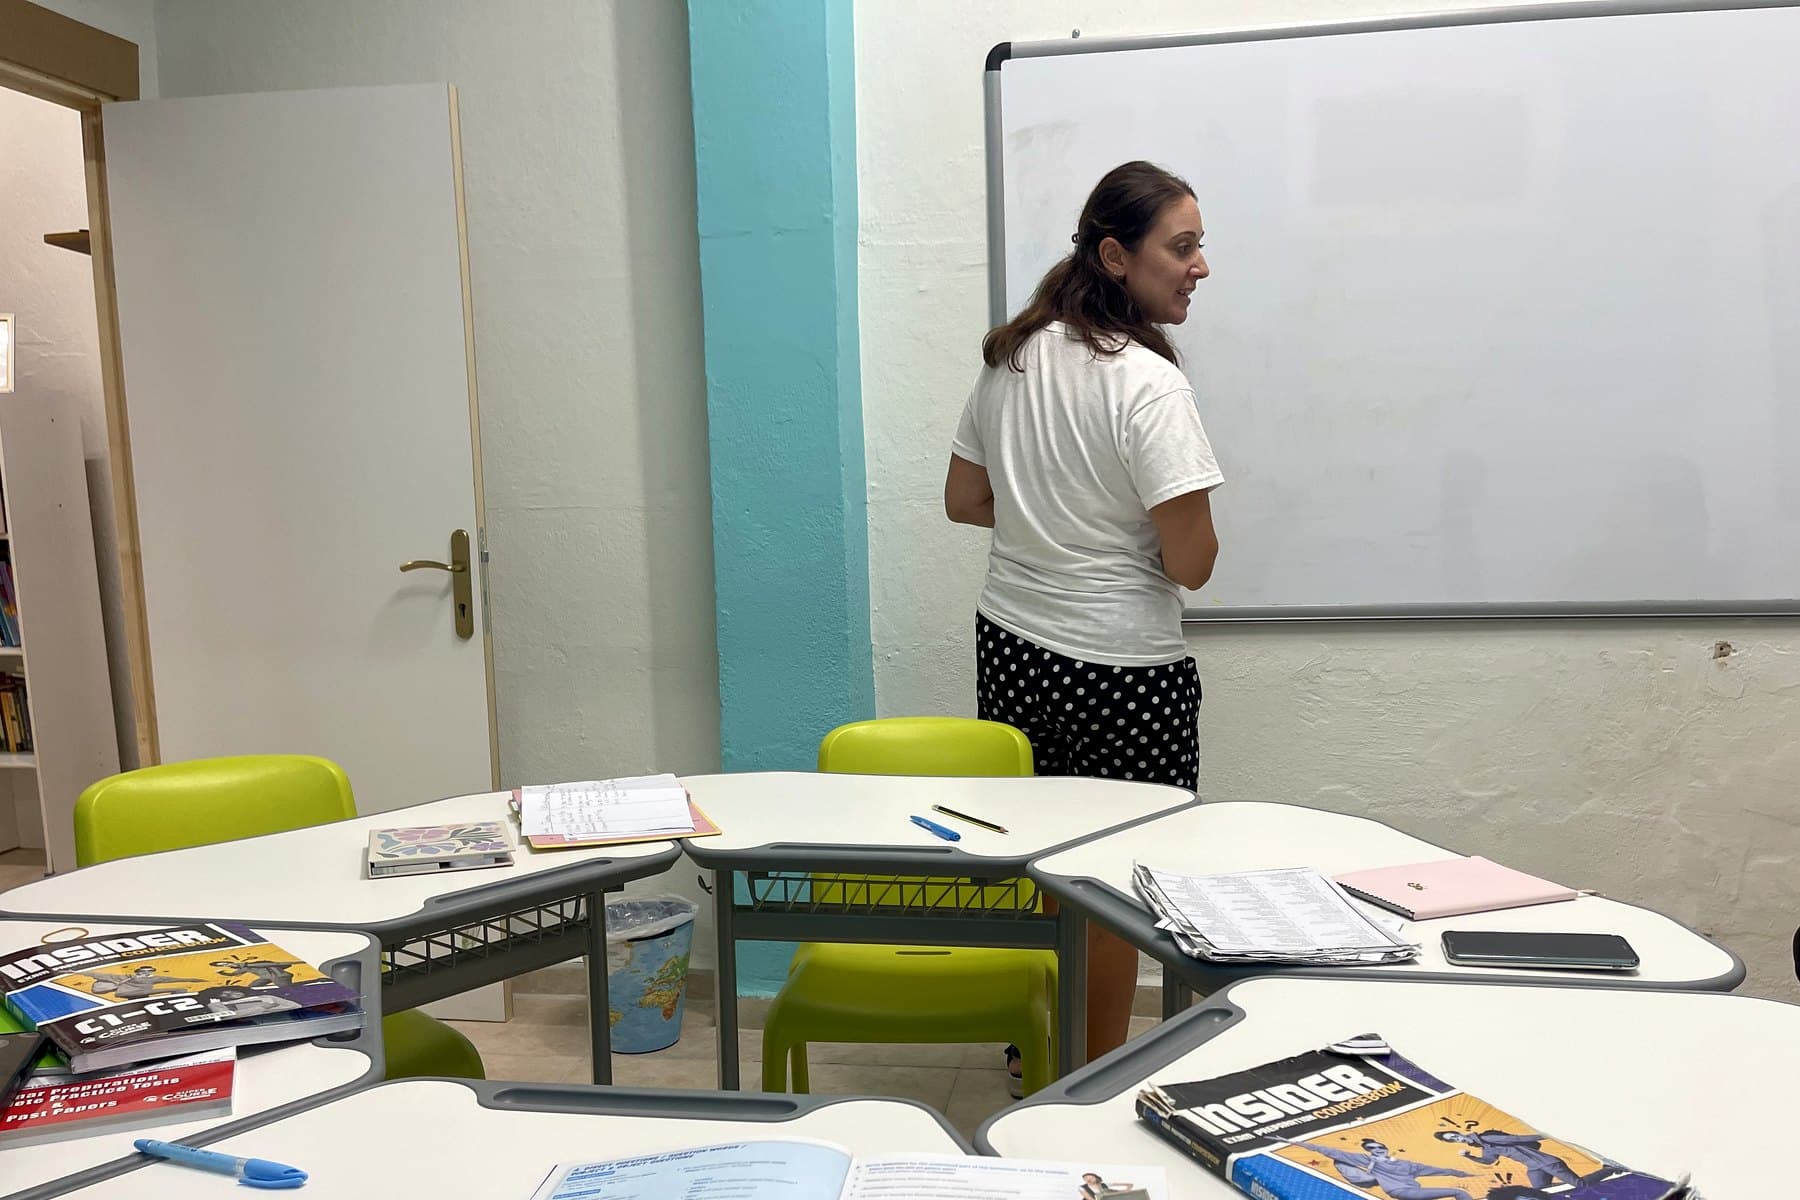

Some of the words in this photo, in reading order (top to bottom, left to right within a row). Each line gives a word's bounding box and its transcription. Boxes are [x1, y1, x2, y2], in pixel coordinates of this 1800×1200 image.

[0, 930, 214, 980] INSIDER
[49, 1074, 159, 1096] Preparation
[49, 1085, 127, 1103] Practice
[132, 1077, 181, 1090] Tests
[161, 1087, 218, 1101] COURSE
[6, 1109, 48, 1123] Past
[52, 1100, 119, 1116] Papers
[1173, 1064, 1386, 1136] INSIDER
[1311, 1081, 1407, 1121] COURSEBOOK
